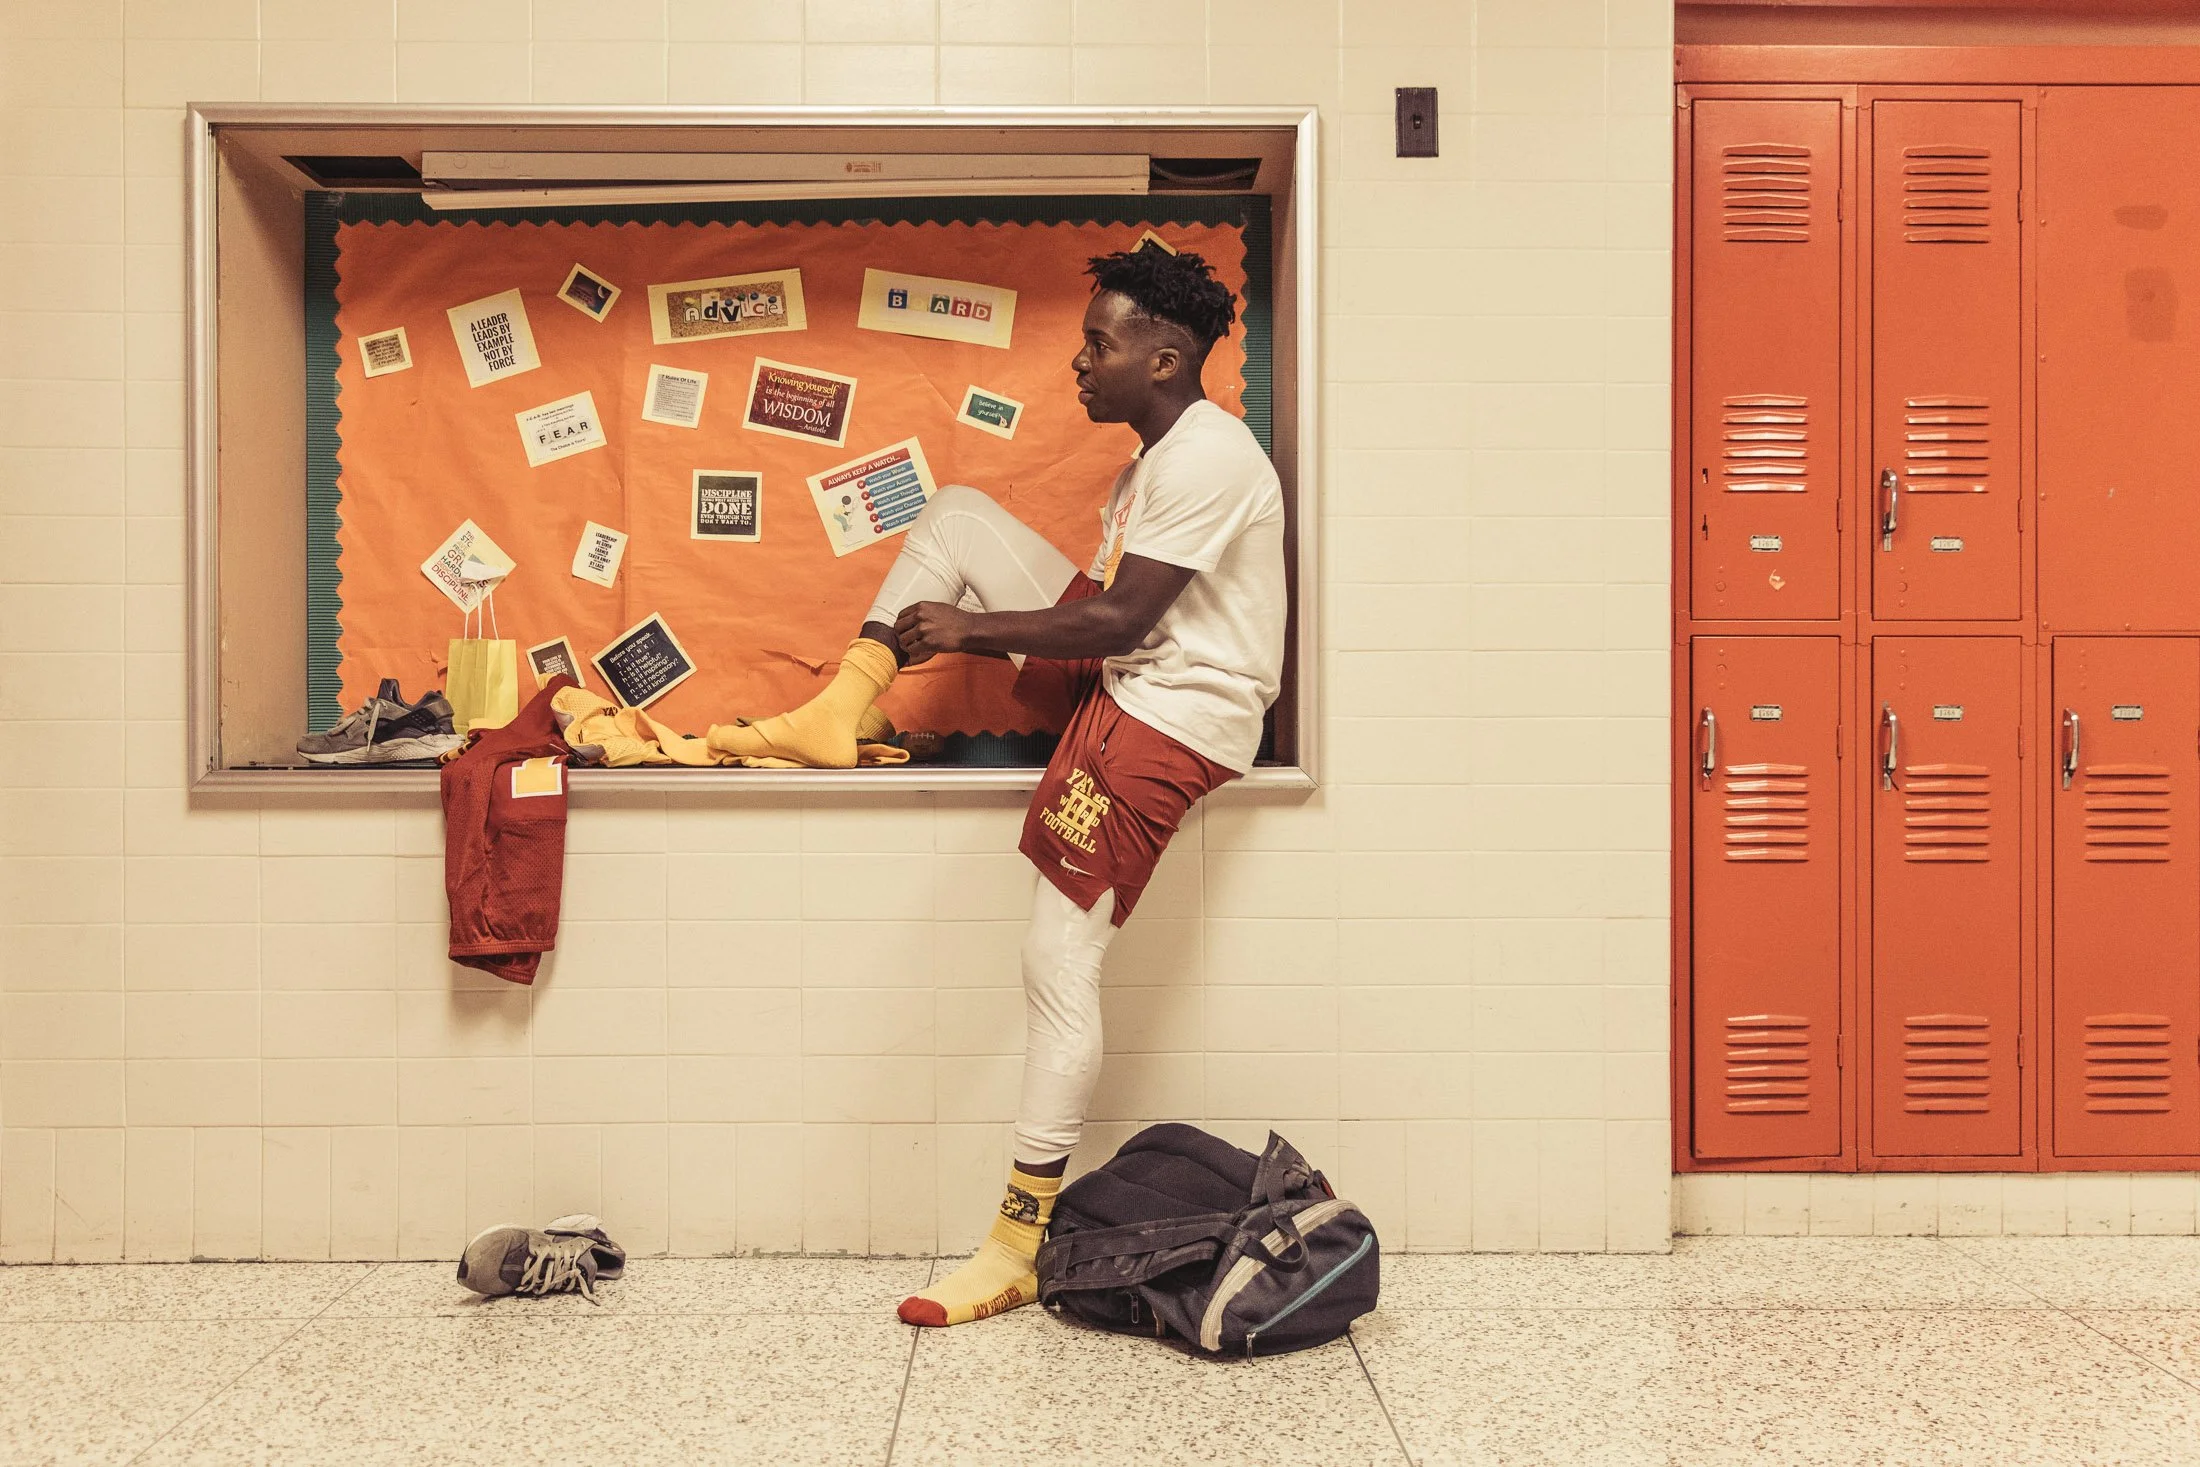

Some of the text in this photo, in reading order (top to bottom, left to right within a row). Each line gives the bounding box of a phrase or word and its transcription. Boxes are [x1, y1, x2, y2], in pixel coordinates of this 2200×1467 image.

[471, 313, 508, 332] A LEADER
[473, 323, 511, 342] LEADS BY
[477, 333, 514, 353] EXAMPLE
[484, 344, 513, 361] NOT BY
[489, 355, 516, 371] FORCE
[768, 372, 804, 391] Knowing
[804, 382, 839, 396] yourself
[766, 386, 773, 394] is
[774, 388, 786, 397] the
[786, 391, 817, 406] beginning
[818, 398, 827, 408] of
[826, 400, 835, 408] all
[803, 424, 827, 434] Aristotle
[828, 470, 852, 486] ALWAYS
[851, 466, 867, 477] KEEP
[868, 475, 882, 483] Watch
[891, 466, 907, 476] Words
[701, 489, 752, 498] DISCIPLINE
[873, 486, 886, 495] Watch
[886, 483, 896, 491] your
[877, 497, 890, 505] Watch
[890, 494, 900, 502] your
[900, 486, 919, 497] Thoughts
[701, 502, 752, 515] DONE
[881, 508, 894, 517] Watch
[894, 505, 904, 513] your
[903, 498, 923, 508] Character
[886, 520, 899, 528] Watch
[900, 516, 909, 524] your
[596, 533, 617, 542] LEADERSHIP
[595, 547, 609, 555] EARNED
[432, 564, 469, 602] DISCIPLINE
[609, 650, 626, 663] Before
[625, 643, 636, 652] you
[635, 652, 650, 664] true?
[639, 652, 662, 670] helpful?
[643, 655, 670, 676] inspiring?
[647, 658, 679, 682] necessary?
[652, 674, 667, 688] kind?
[1039, 806, 1096, 854] FOOTBALL
